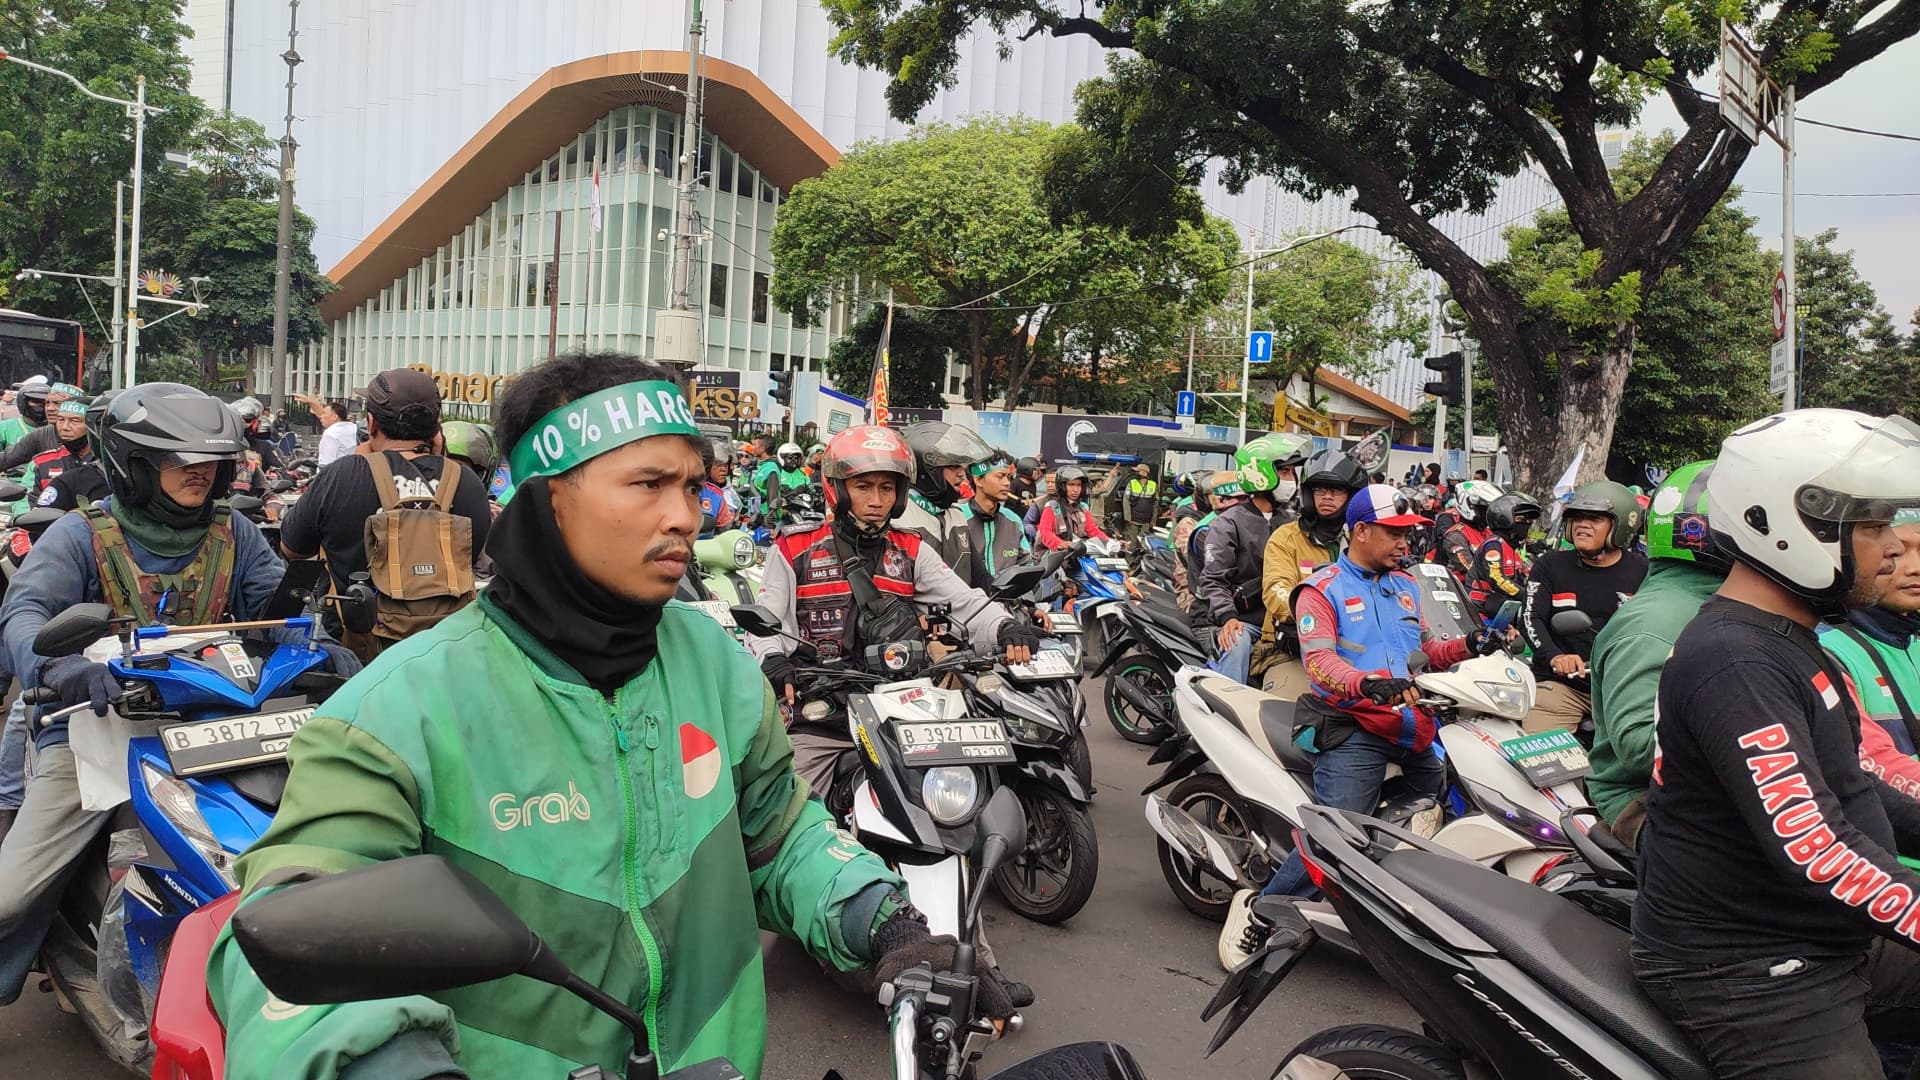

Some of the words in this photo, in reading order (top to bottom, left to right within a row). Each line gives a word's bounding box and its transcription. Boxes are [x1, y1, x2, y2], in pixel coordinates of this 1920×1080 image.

[532, 424, 563, 468] 10
[567, 407, 602, 447] %
[173, 731, 191, 749] B
[203, 720, 266, 744] 3872
[903, 728, 915, 744] B
[923, 726, 963, 743] 3927
[969, 725, 1002, 741] TZK
[1519, 737, 1556, 753] HARGA
[489, 780, 591, 832] Grab
[164, 873, 200, 909] HONDA
